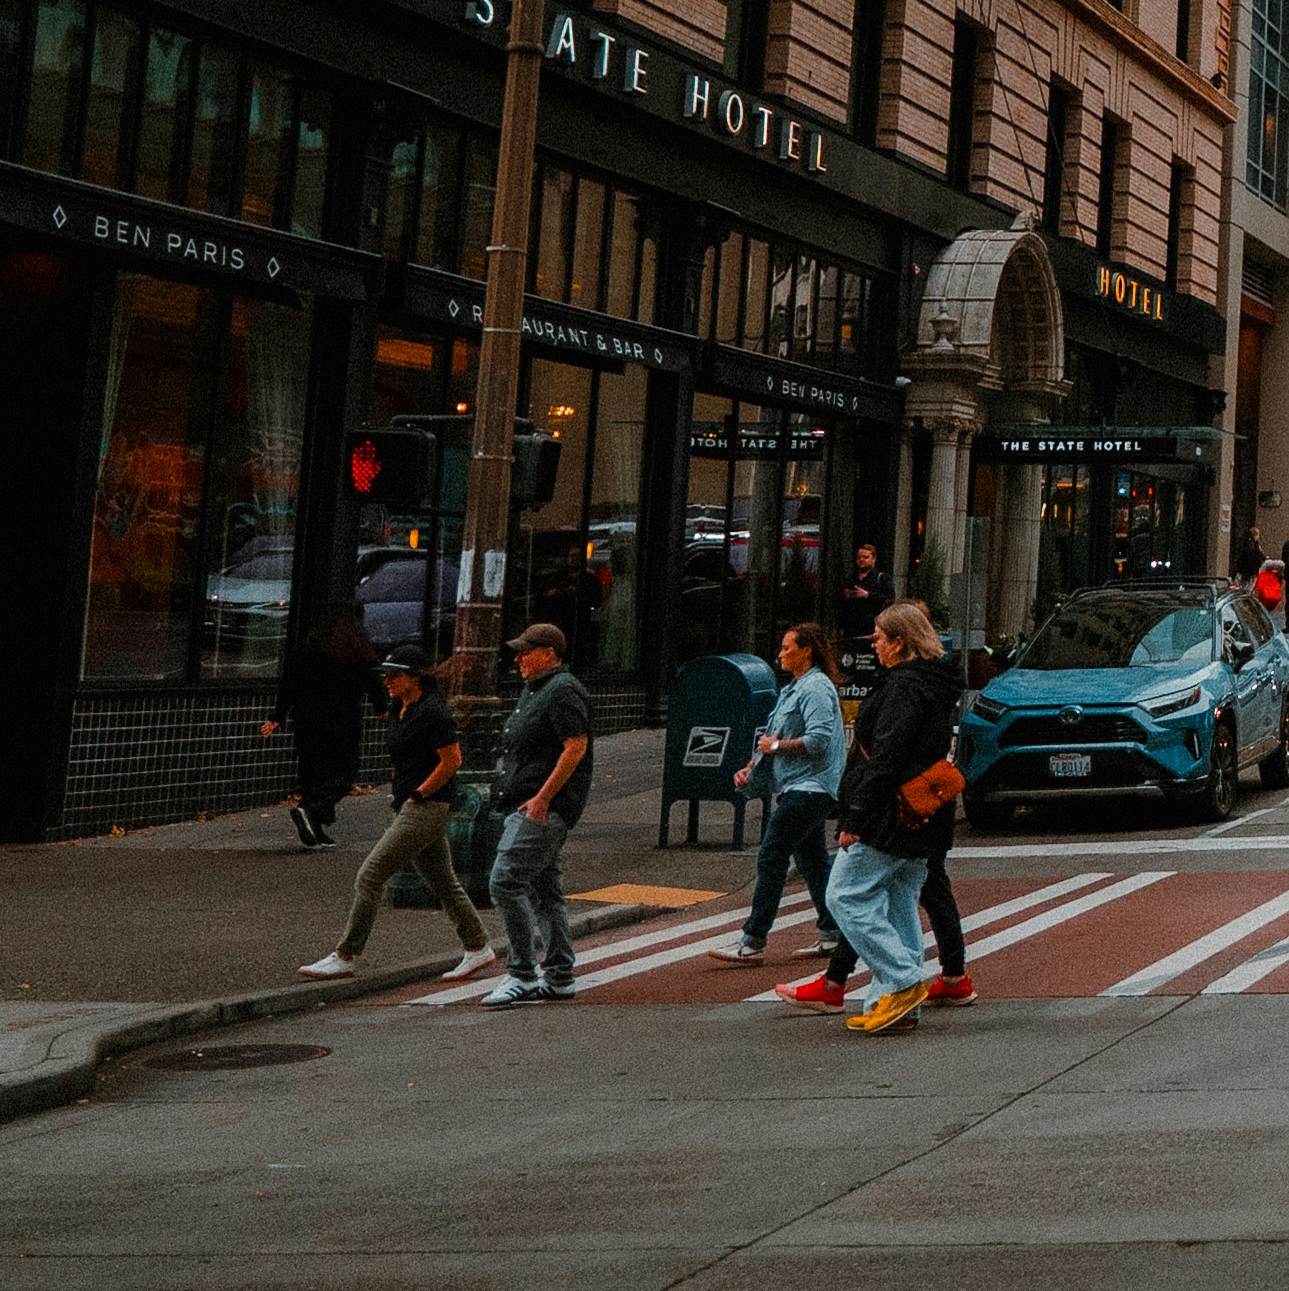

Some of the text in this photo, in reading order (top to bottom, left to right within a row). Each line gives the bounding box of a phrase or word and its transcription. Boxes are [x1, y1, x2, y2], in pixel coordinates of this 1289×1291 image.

[687, 75, 827, 172] HOTEL
[94, 215, 245, 271] BEN PARIS
[1098, 266, 1164, 321] HOTEL
[472, 304, 645, 360] RAURANT & BAR
[781, 379, 845, 408] BEN PARIS
[1001, 440, 1142, 451] THE STATE HOTEL
